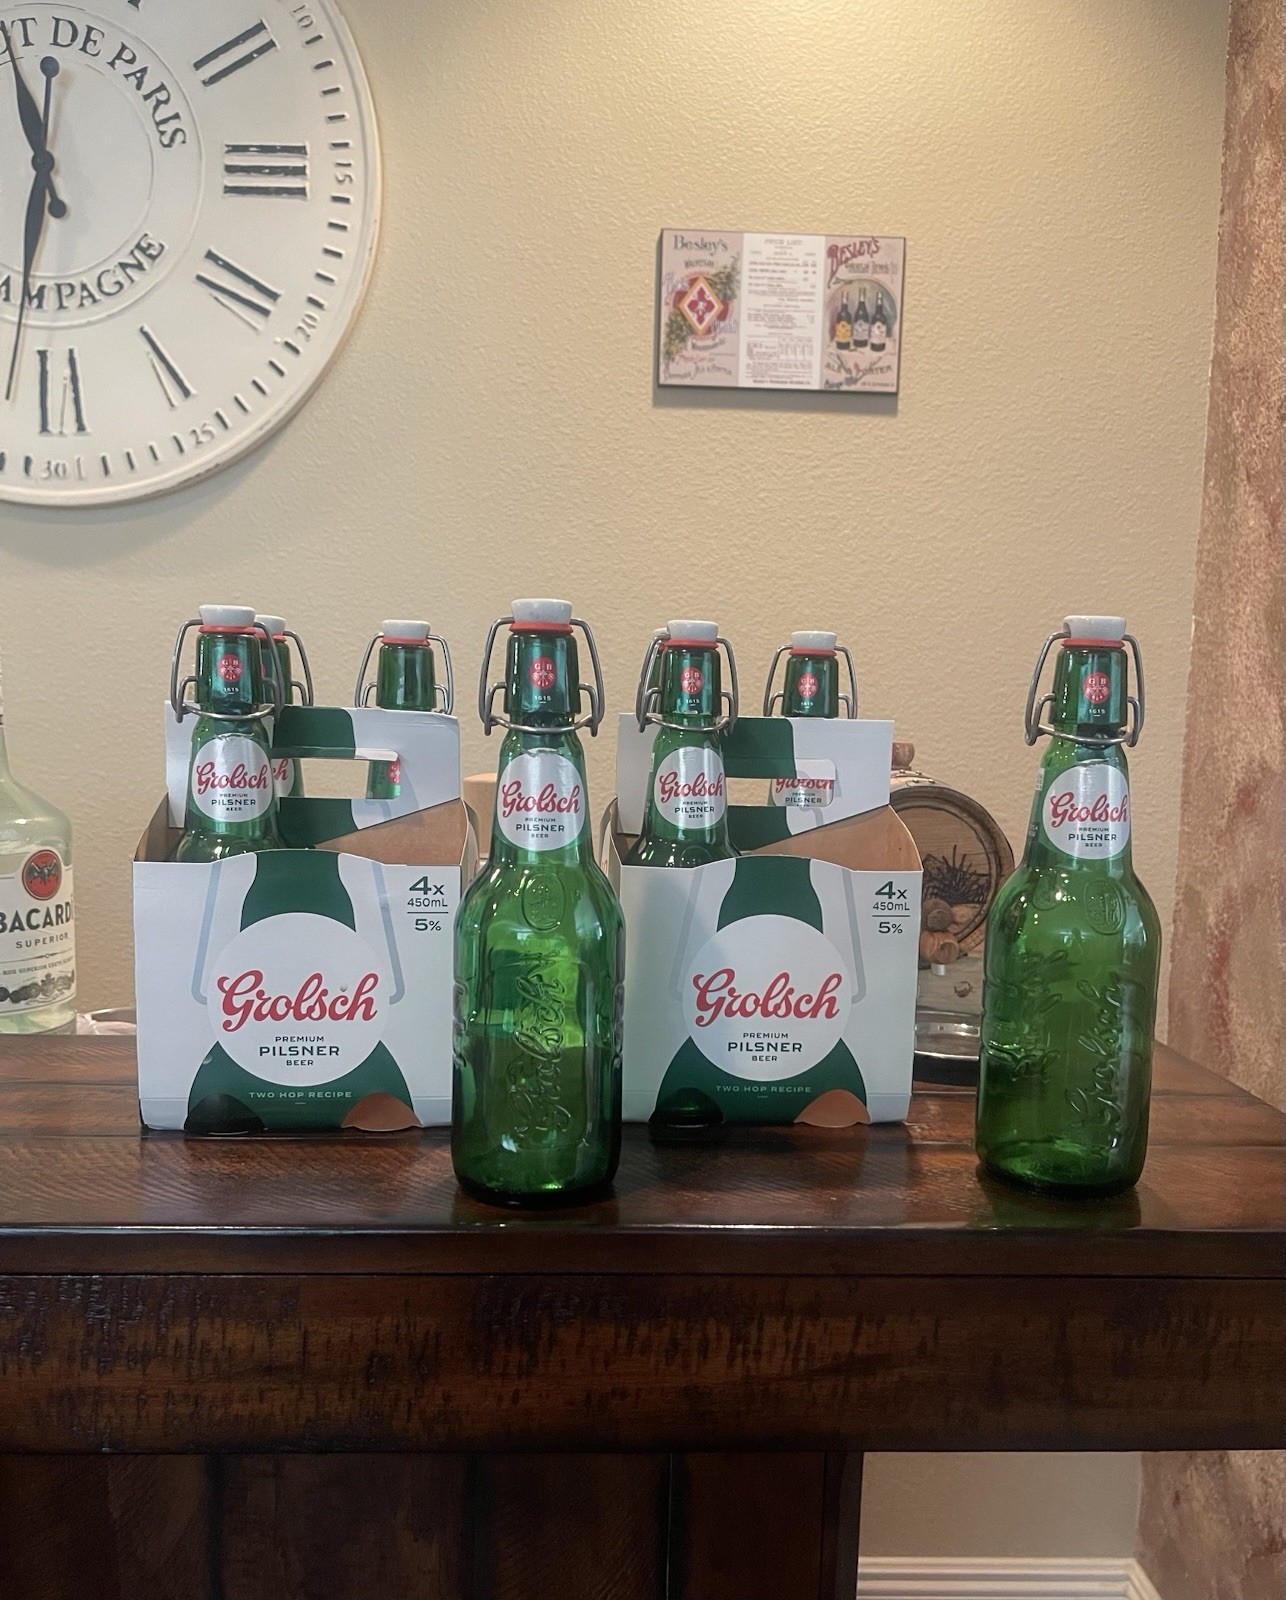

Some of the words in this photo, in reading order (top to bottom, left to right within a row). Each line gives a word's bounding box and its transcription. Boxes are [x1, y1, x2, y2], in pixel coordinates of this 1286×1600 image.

[50, 16, 105, 57] DE
[106, 42, 187, 149] PARIS
[190, 423, 217, 446] 25
[196, 761, 269, 795] Grolsch
[658, 771, 723, 804] Grolsch
[211, 798, 256, 806] PILSNER
[501, 780, 581, 818] Grolsch
[674, 806, 715, 814] PILSNER
[1050, 791, 1128, 828] Grolsch
[515, 824, 565, 833] PILSNER
[1068, 833, 1117, 841] PILSNER
[408, 875, 445, 896] 4x
[874, 880, 907, 900] 4x
[407, 897, 448, 908] 450mL
[872, 902, 910, 911] 450mL
[414, 918, 442, 932] 5%
[878, 921, 903, 934] 5%
[16, 932, 69, 949] SUPERIOR
[216, 969, 379, 1033] Grolsch
[692, 968, 843, 1028] Grolsch
[275, 1035, 325, 1043] PREMIUM
[259, 1045, 340, 1057] PILSNER
[727, 1041, 803, 1053] PILSNER
[249, 1091, 277, 1099] TWO
[279, 1091, 305, 1099] HOP
[308, 1091, 353, 1099] RECIPE
[715, 1085, 741, 1093] TWO
[743, 1085, 768, 1093] HOP
[770, 1085, 812, 1093] RECIPE
